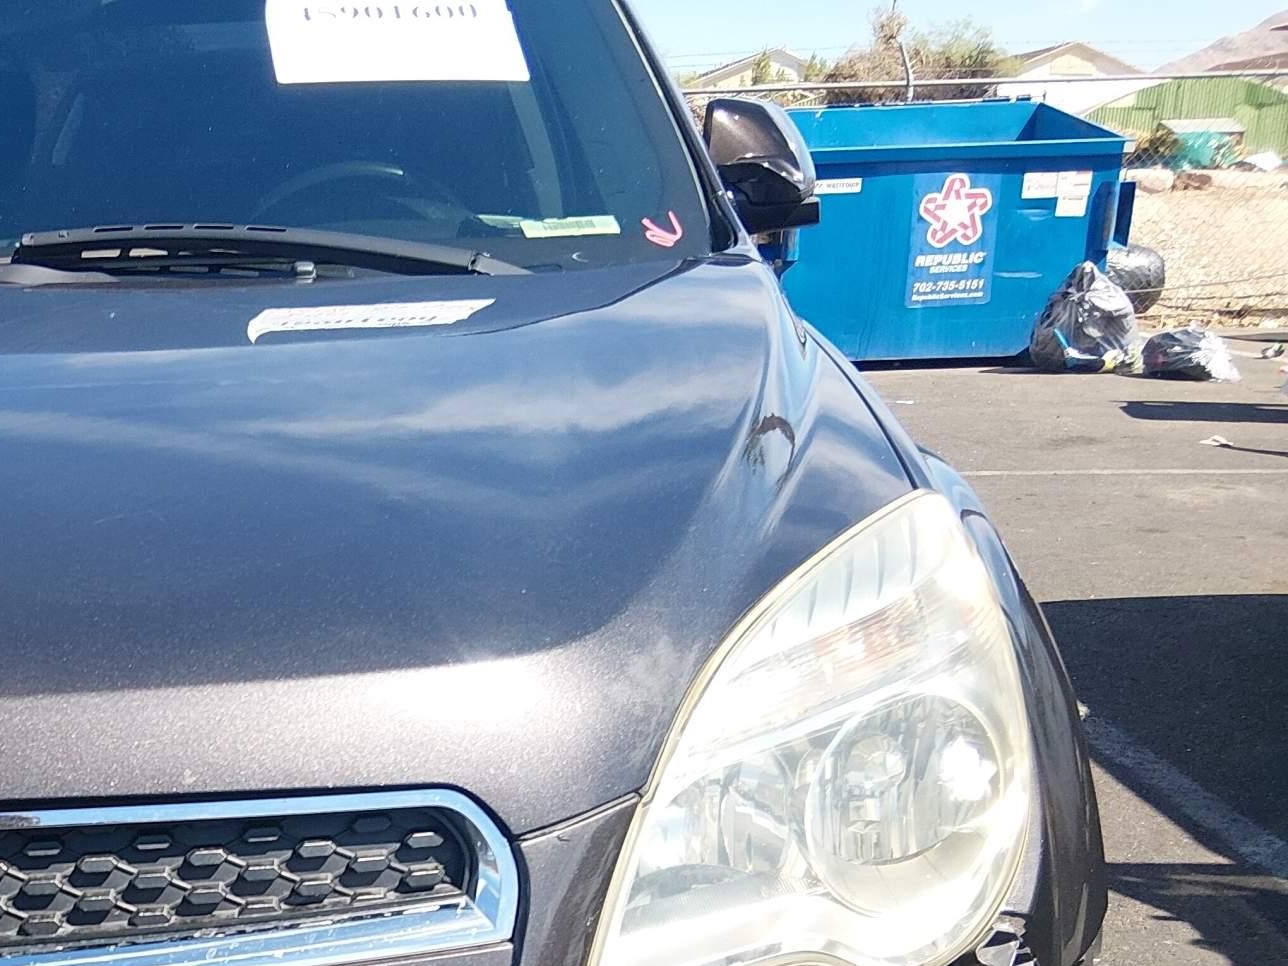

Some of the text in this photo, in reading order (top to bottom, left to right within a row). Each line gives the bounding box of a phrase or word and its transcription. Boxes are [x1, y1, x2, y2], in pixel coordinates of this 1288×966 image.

[303, 4, 478, 21] 901600
[915, 252, 985, 267] REPUBLIC
[929, 265, 968, 274] SERVICES
